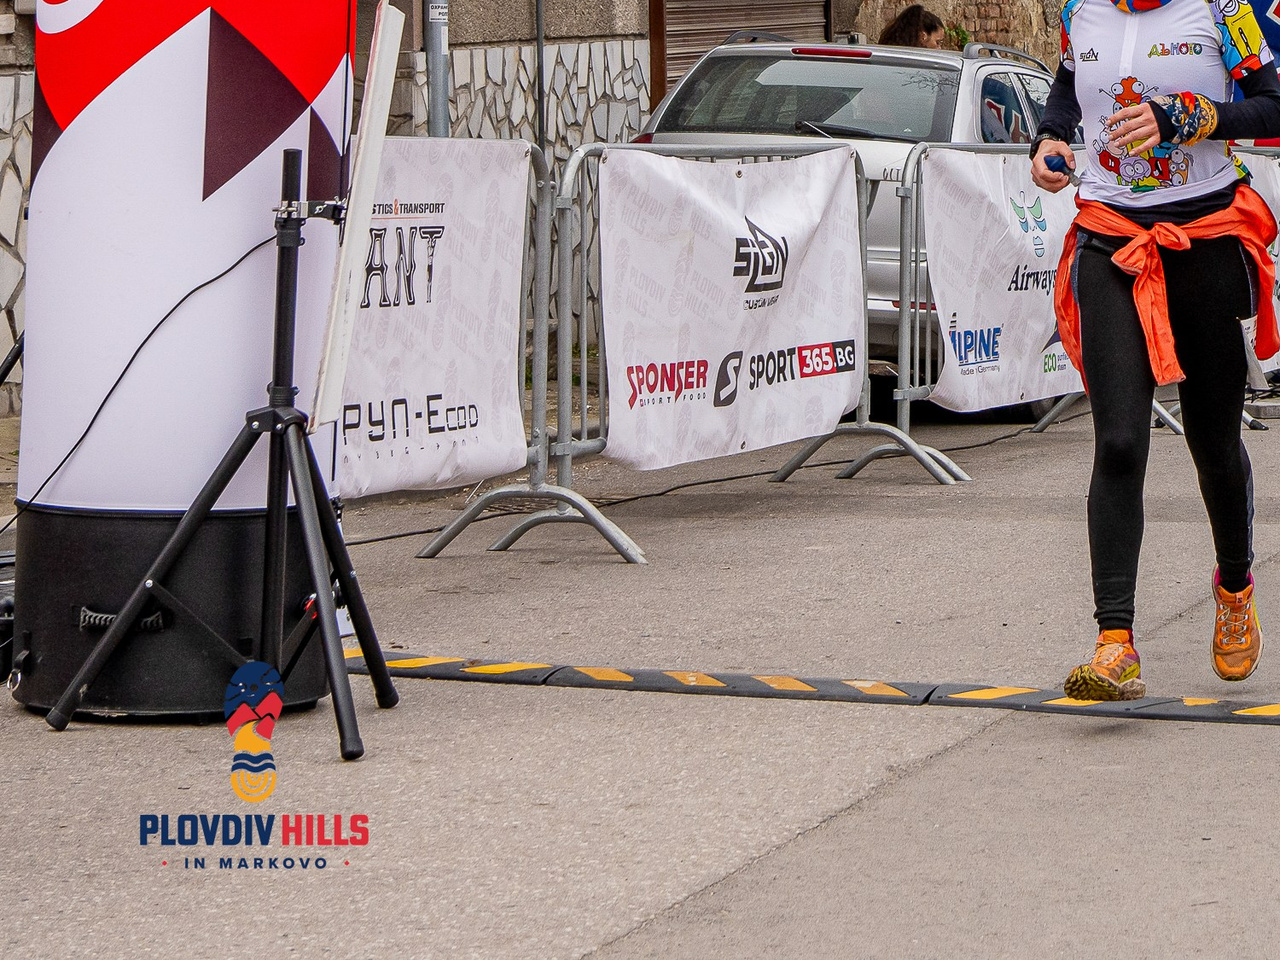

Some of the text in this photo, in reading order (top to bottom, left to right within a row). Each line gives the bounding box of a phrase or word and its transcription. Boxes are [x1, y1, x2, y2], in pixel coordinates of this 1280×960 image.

[360, 226, 445, 308] ANT
[626, 359, 709, 410] SPONSER
[1043, 353, 1057, 373] ECO
